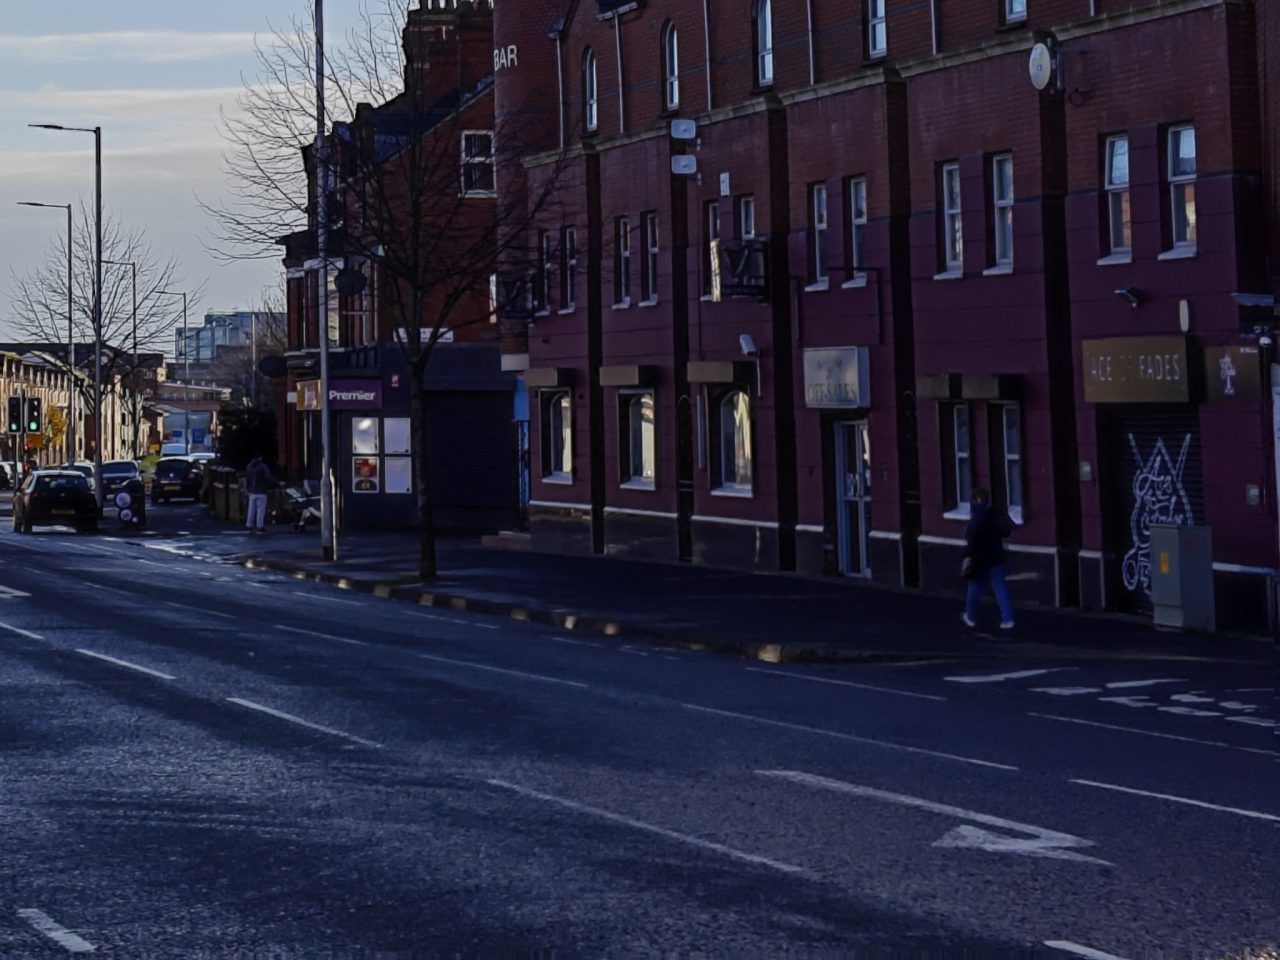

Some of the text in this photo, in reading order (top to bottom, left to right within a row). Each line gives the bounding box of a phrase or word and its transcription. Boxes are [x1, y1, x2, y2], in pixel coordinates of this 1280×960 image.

[493, 44, 518, 71] BAR
[1090, 356, 1113, 381] ACE
[1139, 354, 1180, 381] FADES
[328, 390, 376, 401] Premier
